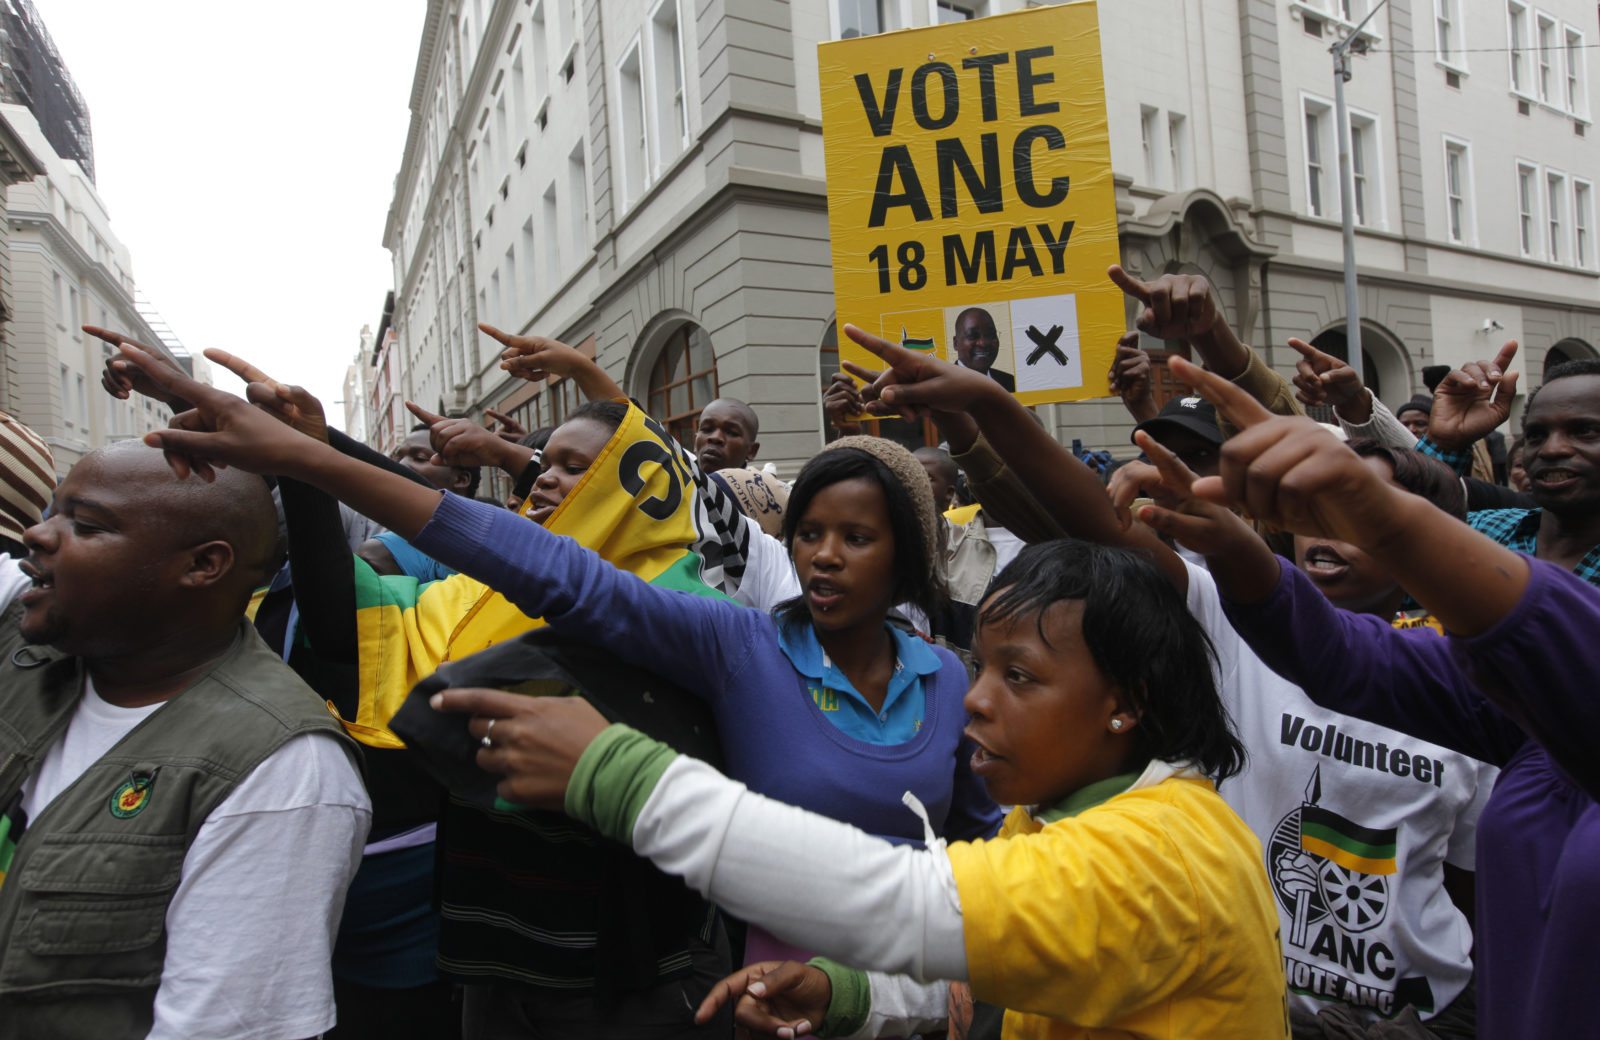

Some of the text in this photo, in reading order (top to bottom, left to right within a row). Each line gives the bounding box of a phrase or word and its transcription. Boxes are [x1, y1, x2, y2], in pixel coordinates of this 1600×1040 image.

[853, 45, 1060, 138] VOTE
[868, 124, 1070, 228] ANC
[868, 220, 1076, 294] 18 MAY
[1280, 713, 1444, 788] Volunteer
[1309, 923, 1396, 982] ANC
[1341, 980, 1395, 1017] ANC
